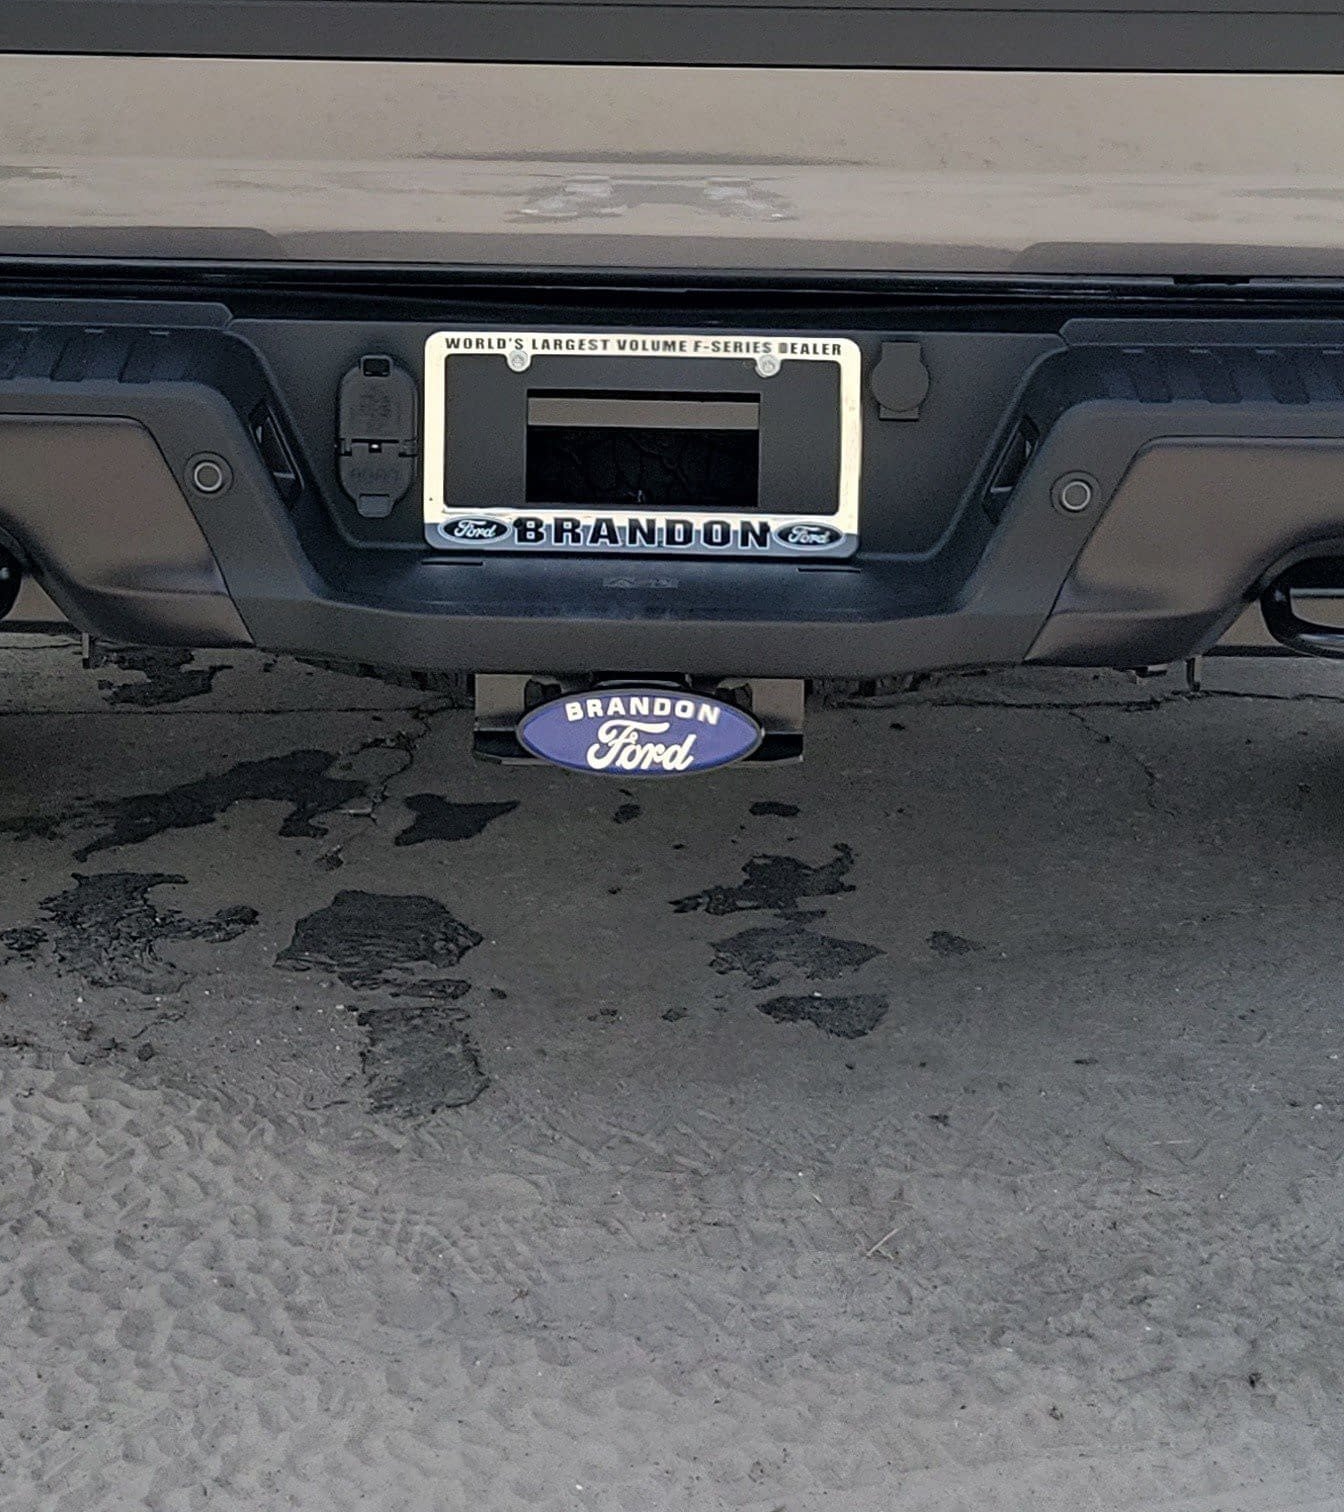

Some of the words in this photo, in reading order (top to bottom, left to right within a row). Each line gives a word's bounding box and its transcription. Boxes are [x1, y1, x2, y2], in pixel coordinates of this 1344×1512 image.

[445, 337, 524, 350] WORLD'S
[531, 338, 610, 351] LARGEST
[616, 338, 687, 353] VOLUME
[693, 339, 772, 354] F-SERIES
[778, 341, 842, 356] DEALER
[453, 519, 498, 539] Ford
[512, 516, 771, 548] BRANDON
[787, 525, 831, 544] Ford
[566, 697, 720, 724] BRANDON
[587, 719, 697, 771] Ford
